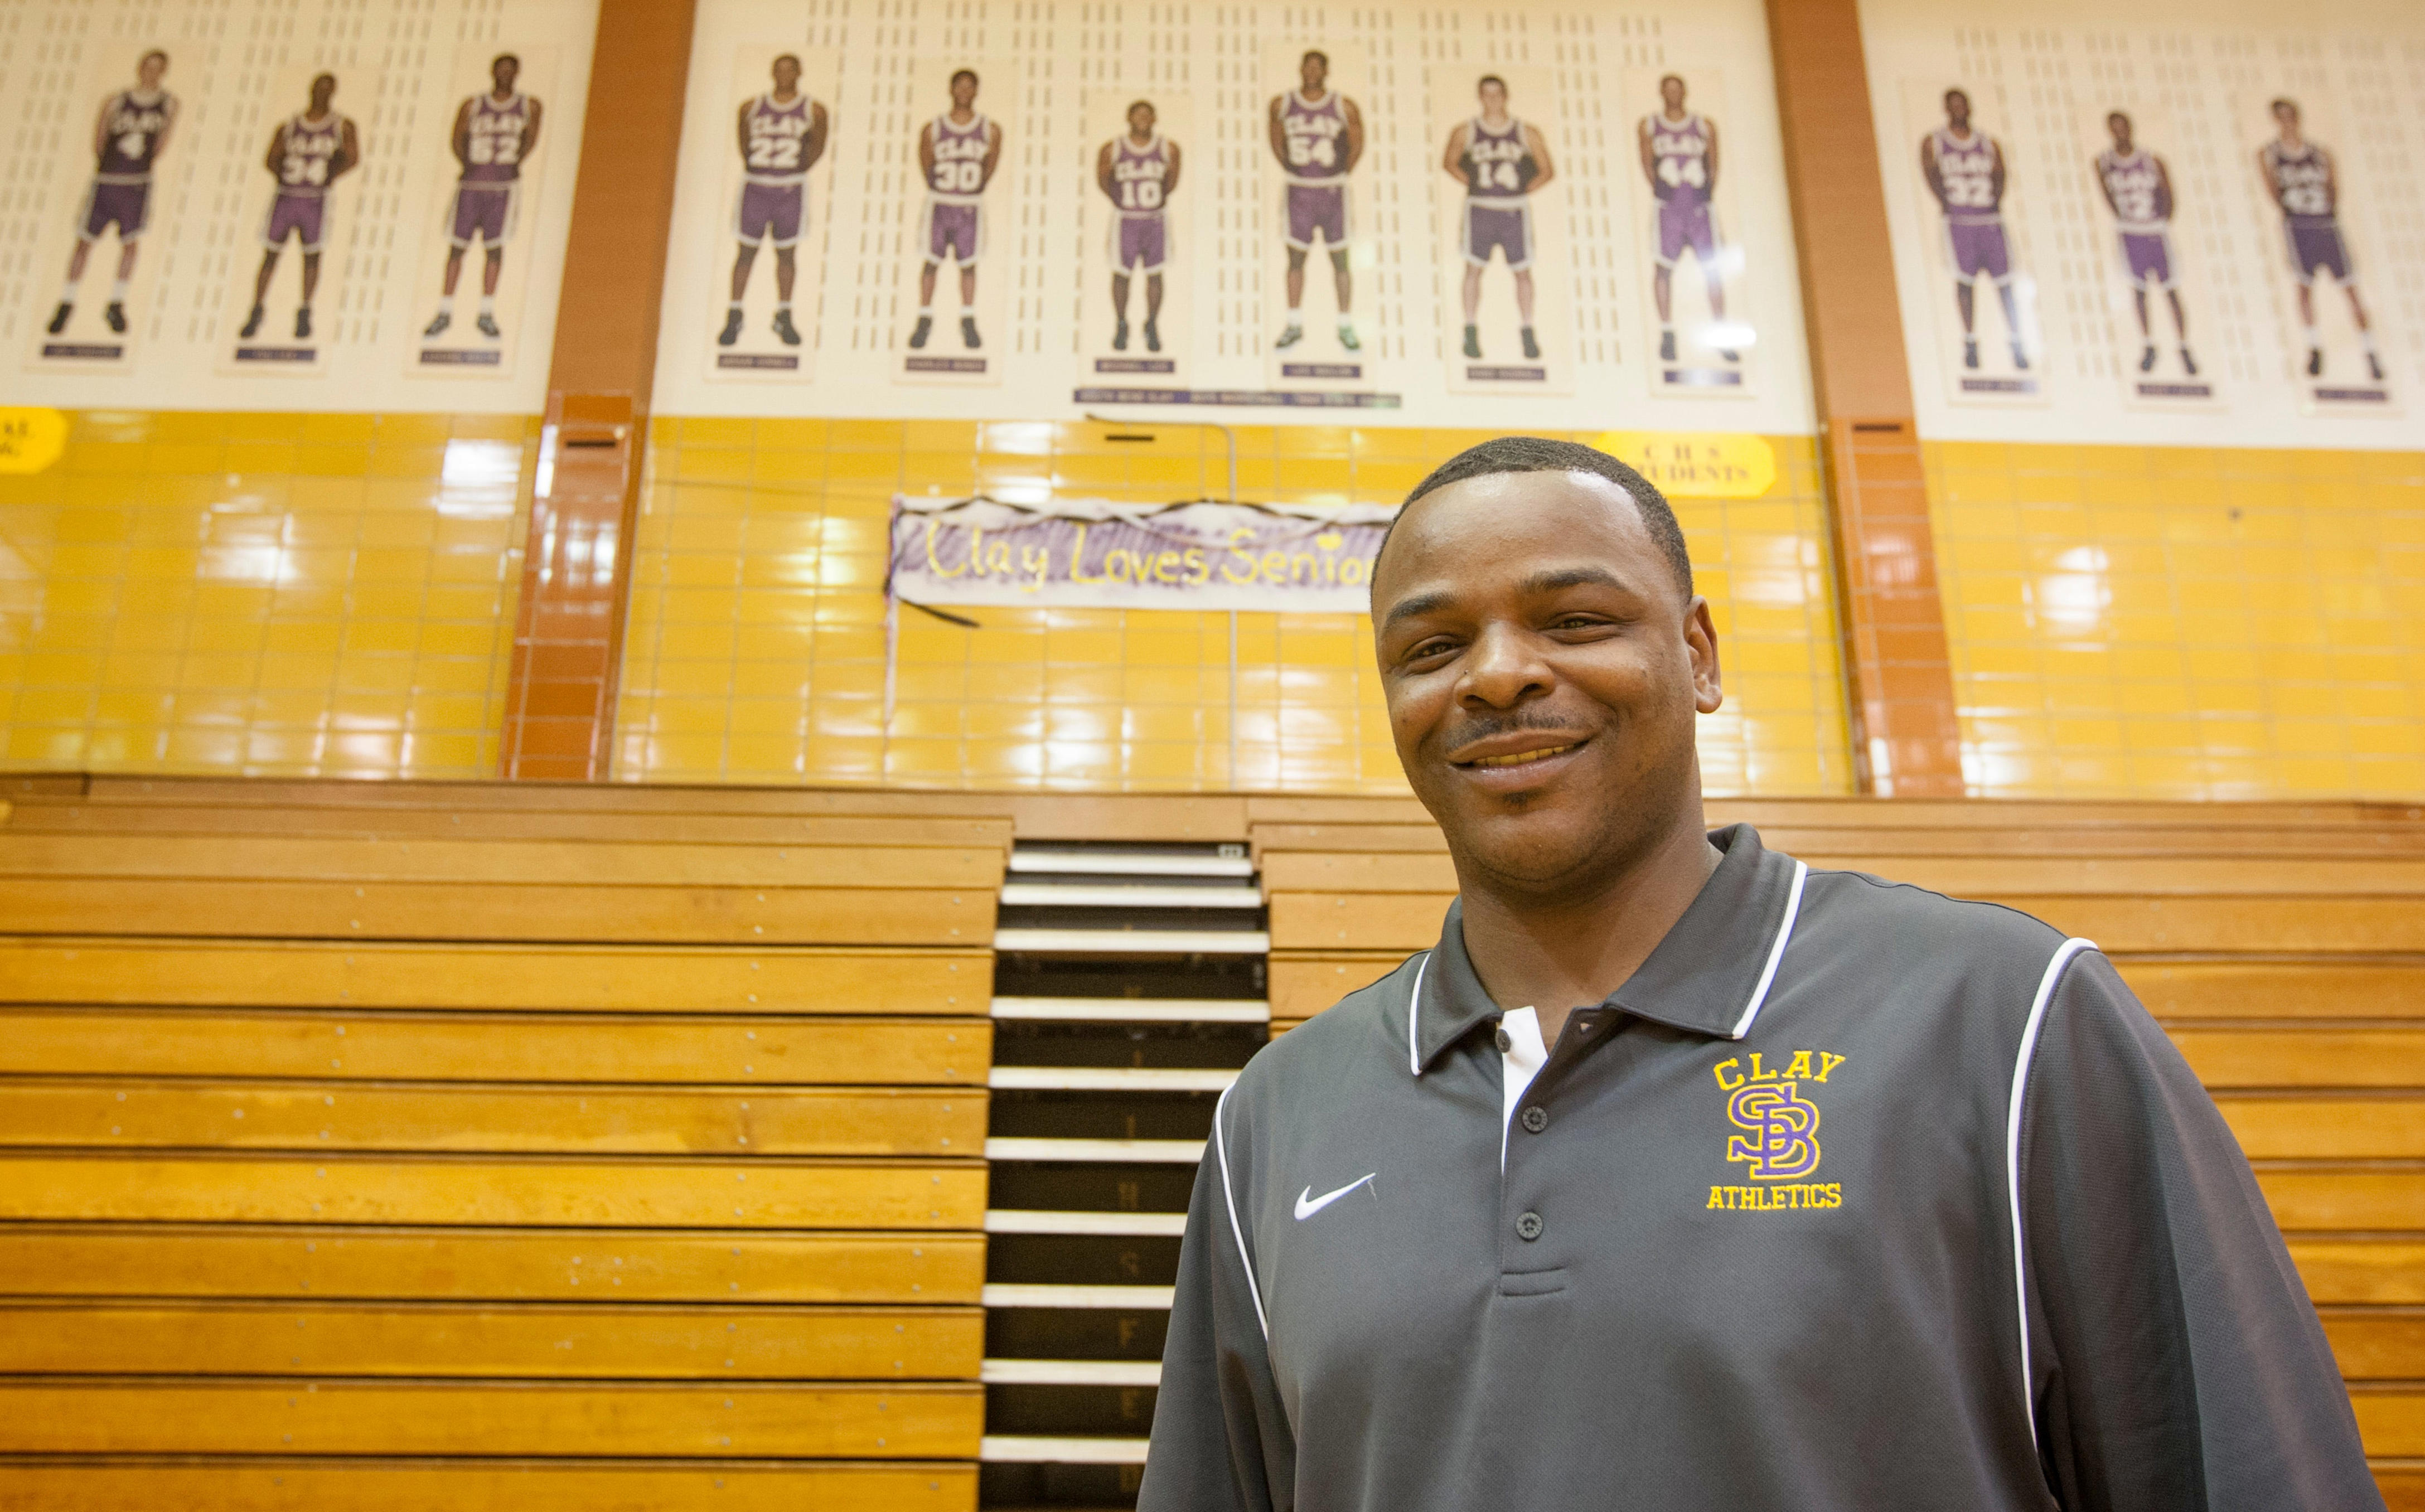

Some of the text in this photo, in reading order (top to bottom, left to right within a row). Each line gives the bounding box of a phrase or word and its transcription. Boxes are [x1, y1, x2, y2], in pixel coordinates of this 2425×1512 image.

[748, 136, 800, 168] 22
[934, 138, 989, 161] CLAY
[1287, 135, 1336, 168] 54
[934, 161, 982, 192] 30
[1477, 162, 1519, 191] 14
[1657, 157, 1706, 189] 44
[1121, 181, 1163, 209] 10
[926, 518, 1049, 593] Clay
[1069, 521, 1209, 585] Loves
[1713, 1050, 1846, 1091] CLAY
[1706, 1183, 1842, 1210] ATHLETICS
